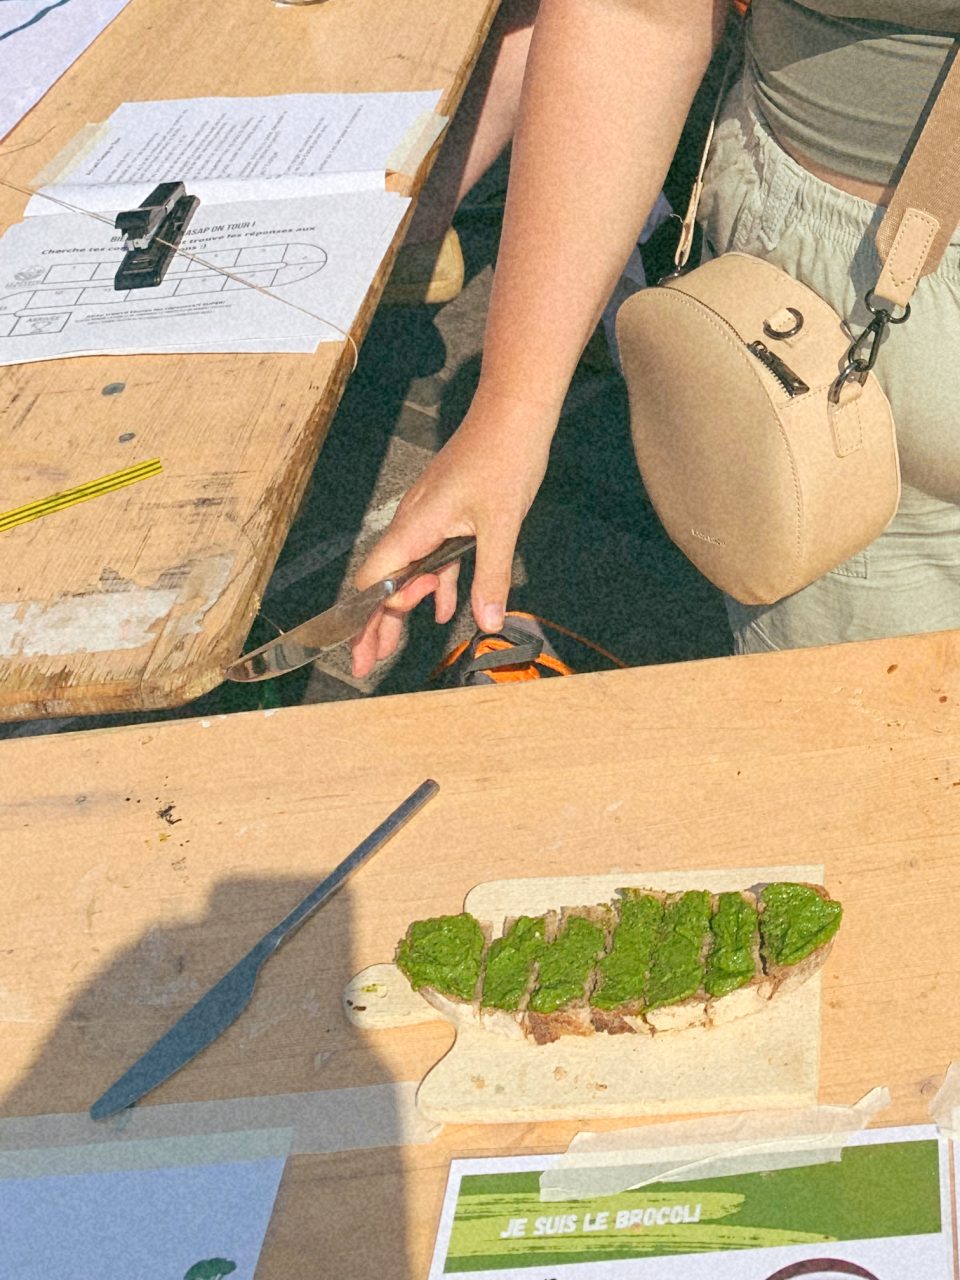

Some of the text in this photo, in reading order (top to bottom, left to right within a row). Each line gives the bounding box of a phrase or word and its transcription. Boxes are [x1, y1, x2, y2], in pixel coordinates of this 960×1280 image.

[500, 1203, 702, 1239] JE SUIS LE BROCOLI
